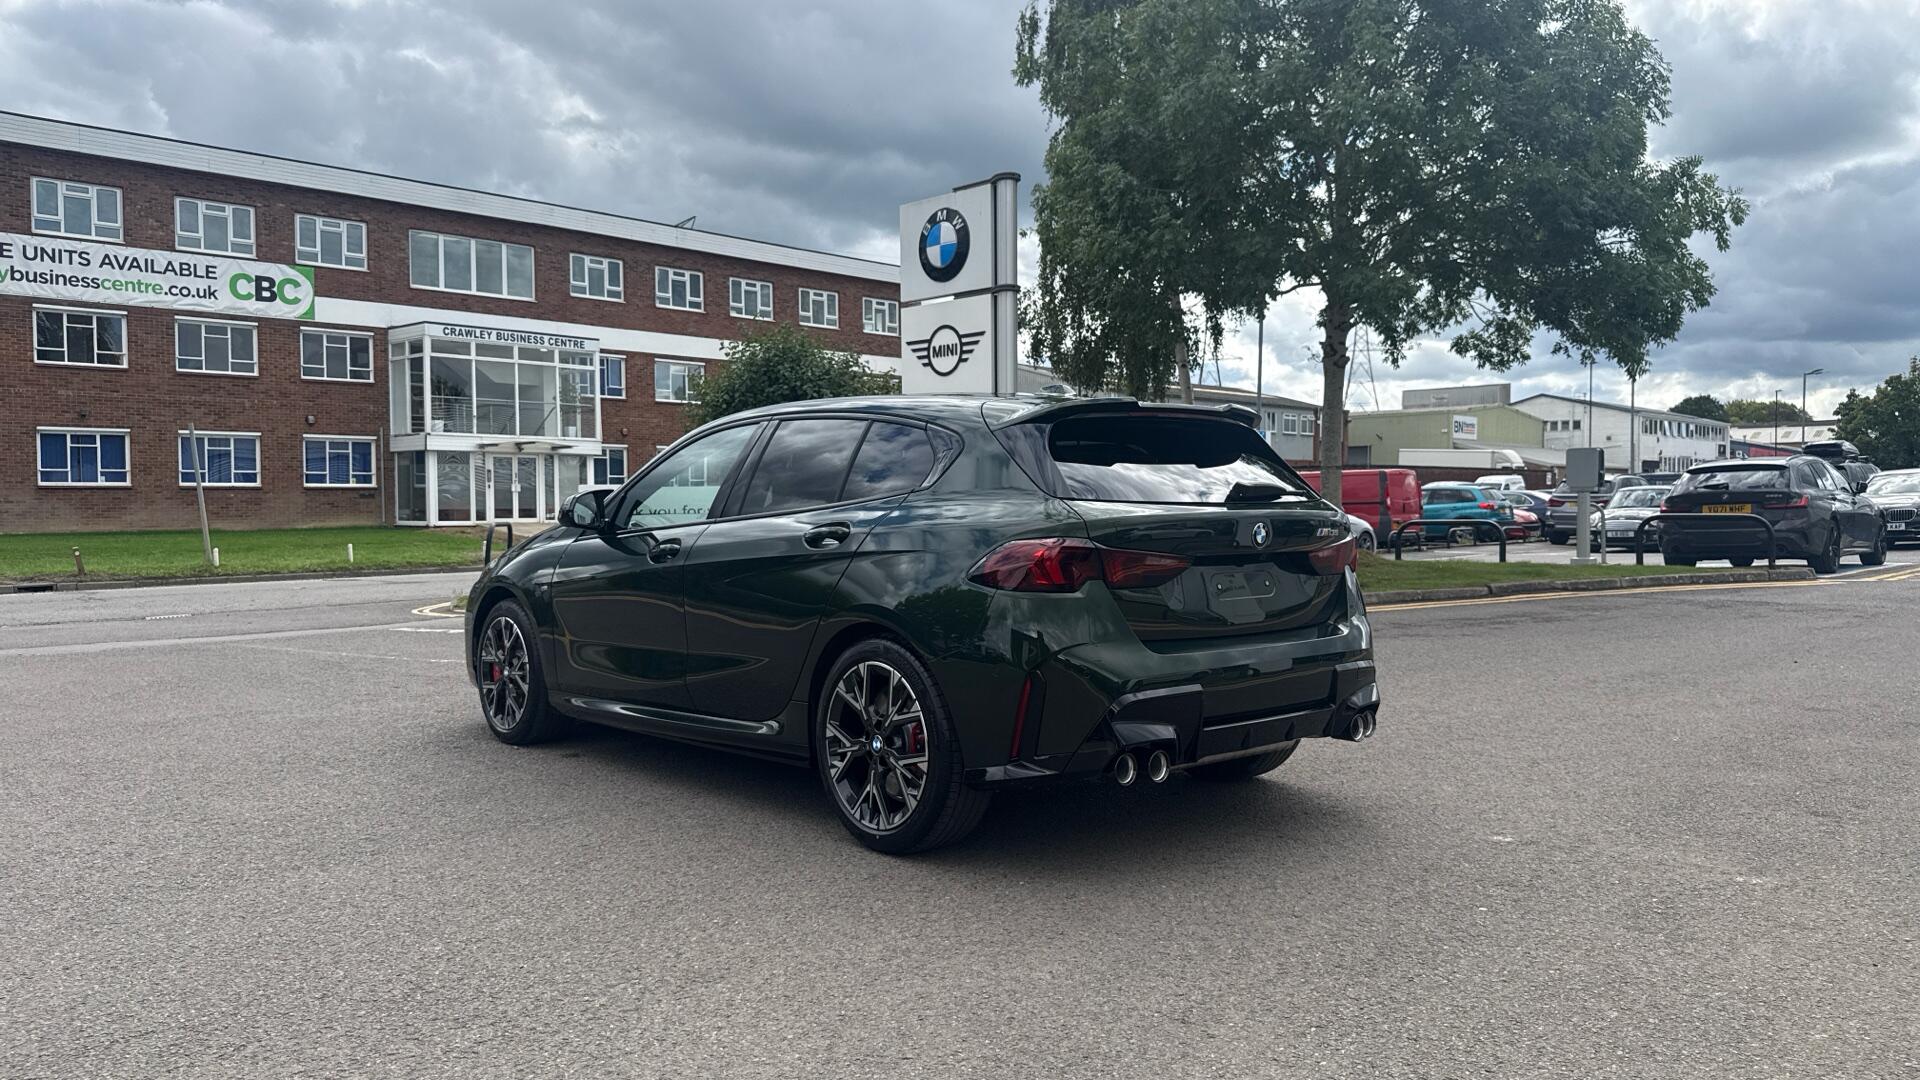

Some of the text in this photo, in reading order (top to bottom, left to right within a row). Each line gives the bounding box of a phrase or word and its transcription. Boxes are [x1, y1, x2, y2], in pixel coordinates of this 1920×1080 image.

[922, 209, 964, 236] BMW
[22, 244, 91, 267] UNITS
[99, 253, 218, 280] AVAILABLE
[229, 272, 301, 305] CBC
[442, 326, 586, 349] CRAWLEY BUSINESS CENTRE
[932, 342, 958, 359] MINI
[1454, 420, 1463, 433] BN
